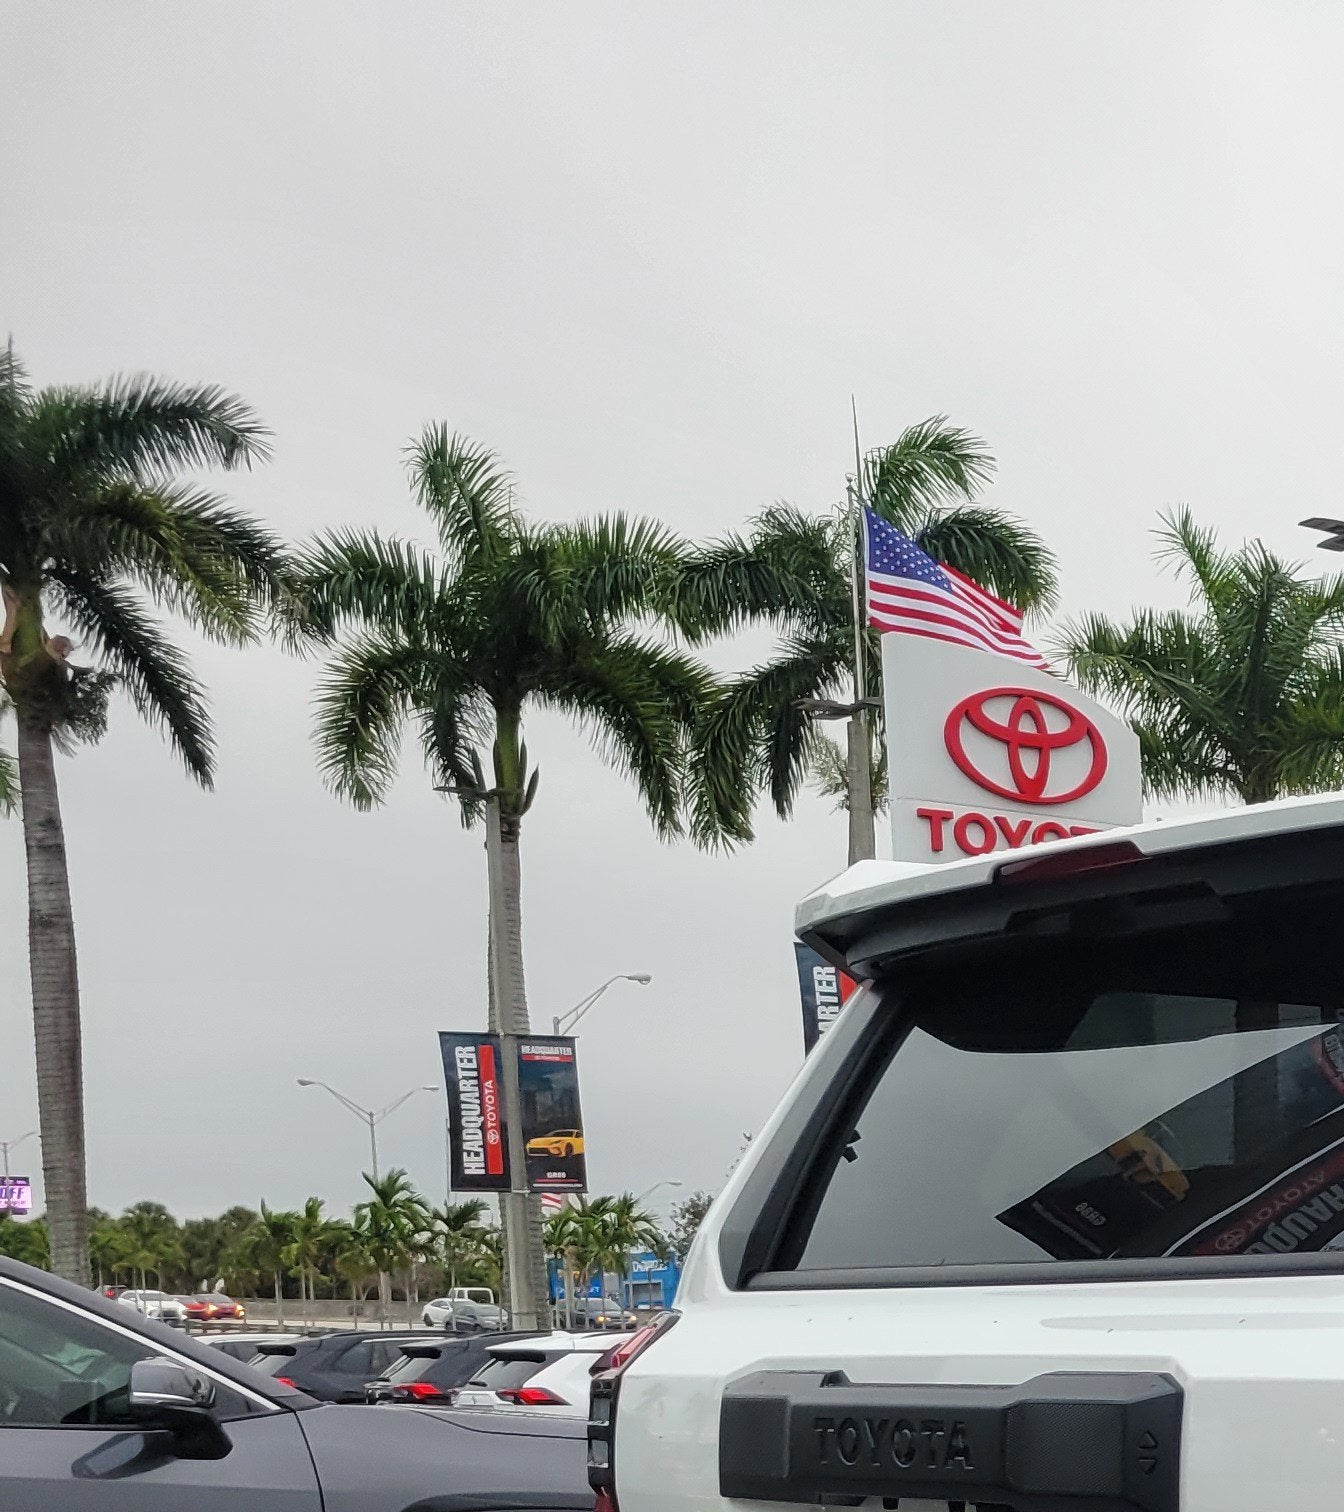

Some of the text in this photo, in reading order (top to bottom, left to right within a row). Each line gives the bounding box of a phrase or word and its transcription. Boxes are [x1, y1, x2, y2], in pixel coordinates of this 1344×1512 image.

[916, 807, 1104, 856] TOY
[455, 1045, 485, 1175] HEADQUARTER
[484, 1080, 497, 1128] TOYOTA
[814, 1417, 974, 1470] TOYOTA
